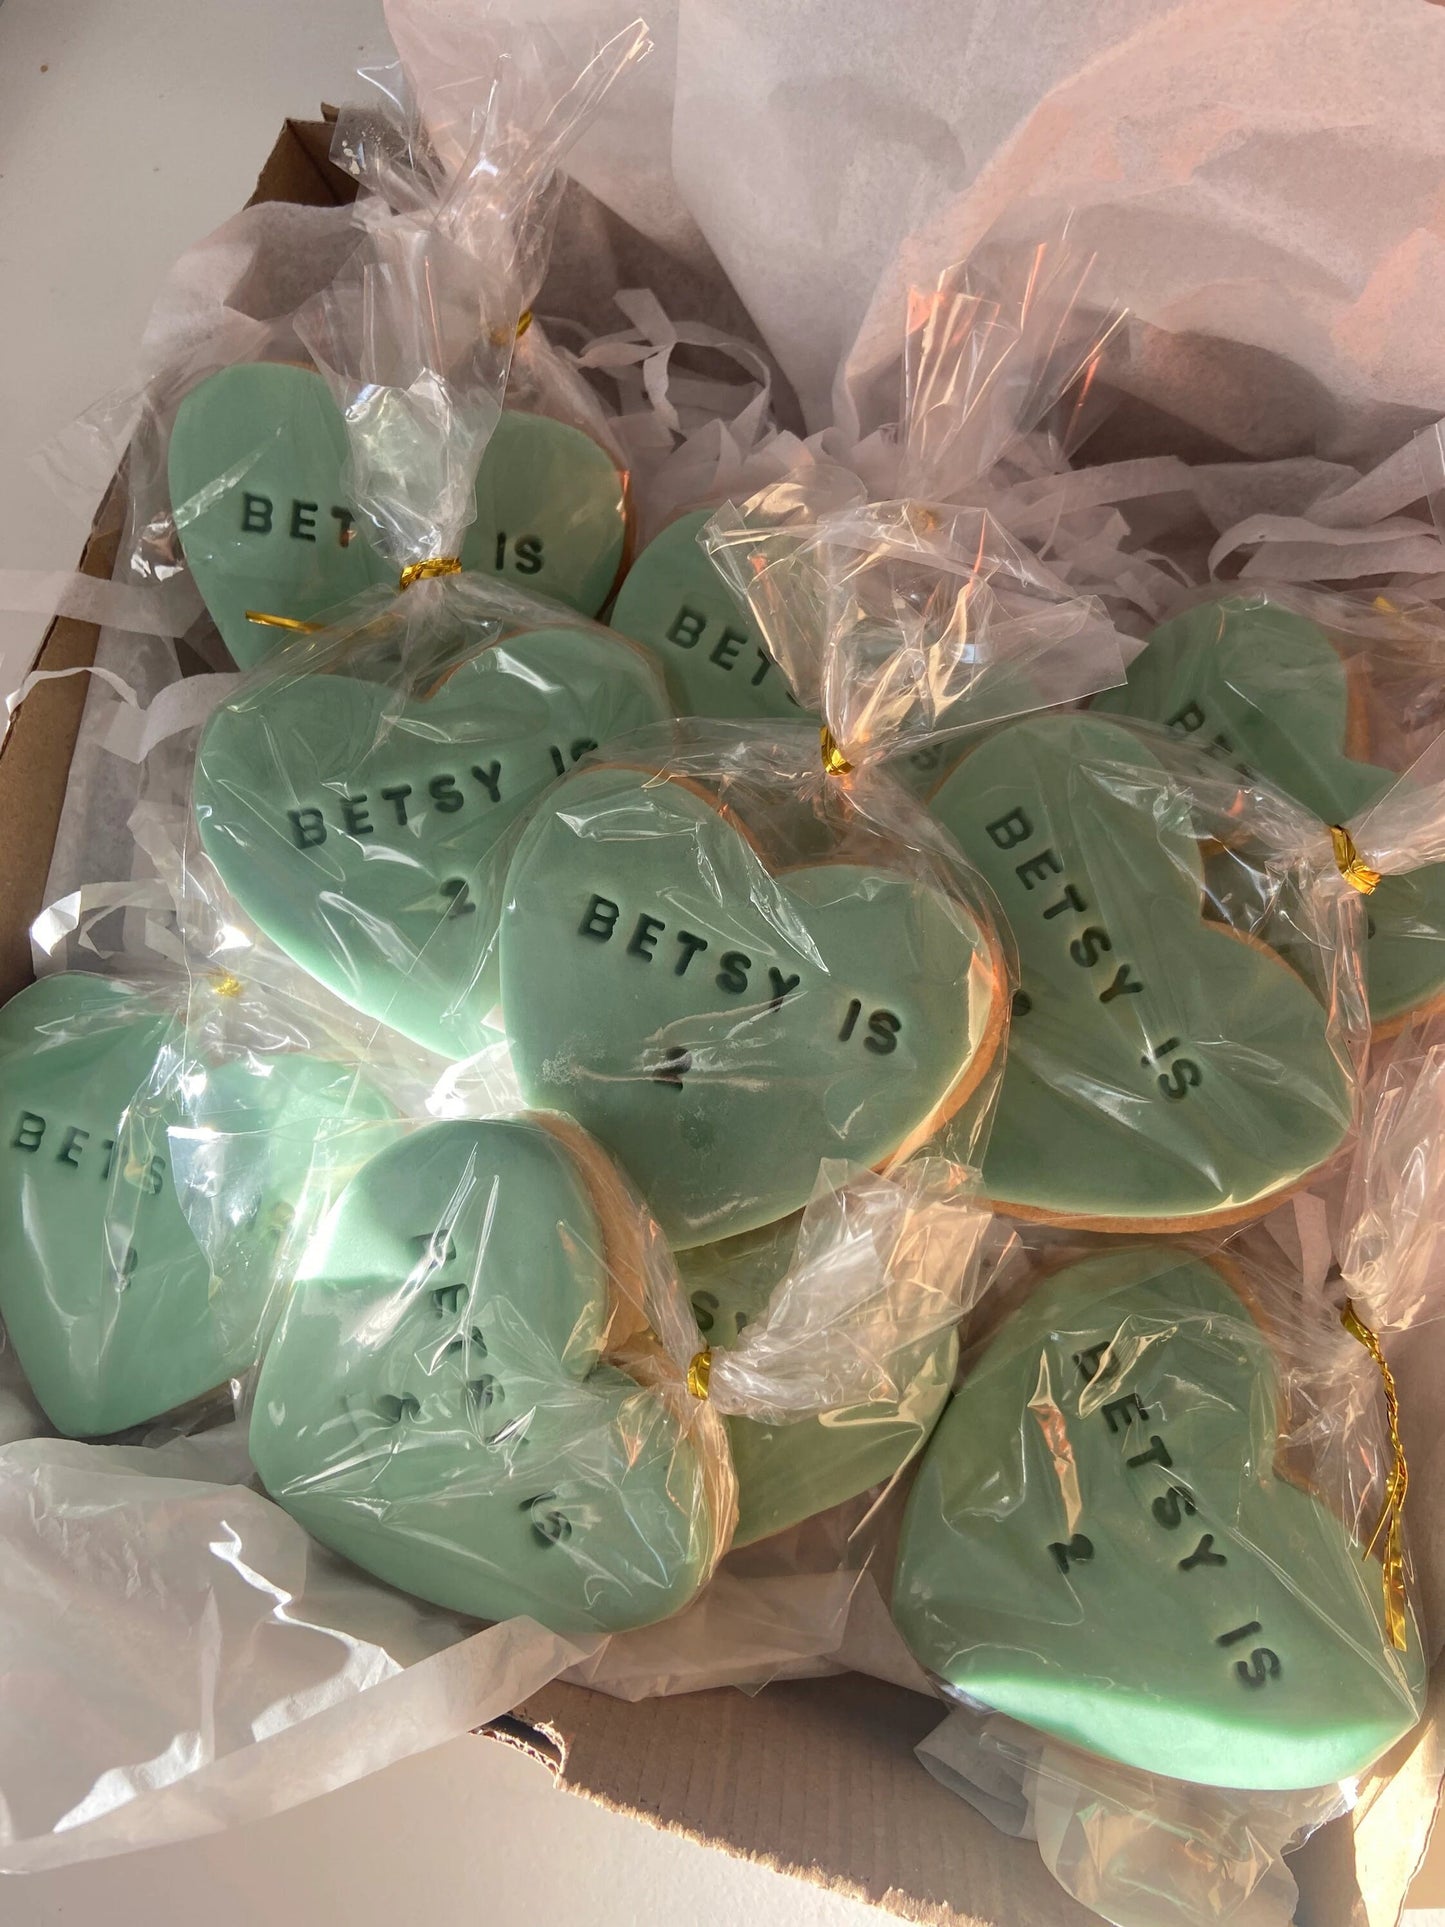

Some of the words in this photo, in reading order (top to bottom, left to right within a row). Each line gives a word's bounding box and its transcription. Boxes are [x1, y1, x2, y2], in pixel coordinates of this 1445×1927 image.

[495, 532, 545, 575] IS
[286, 760, 502, 850] BETSY
[577, 894, 801, 1012] BETSY
[838, 999, 902, 1056] IS
[985, 806, 1144, 1004] BETSY
[1140, 1037, 1200, 1101] IS
[1073, 1341, 1228, 1571] BETSY
[1216, 1620, 1283, 1691] IS
